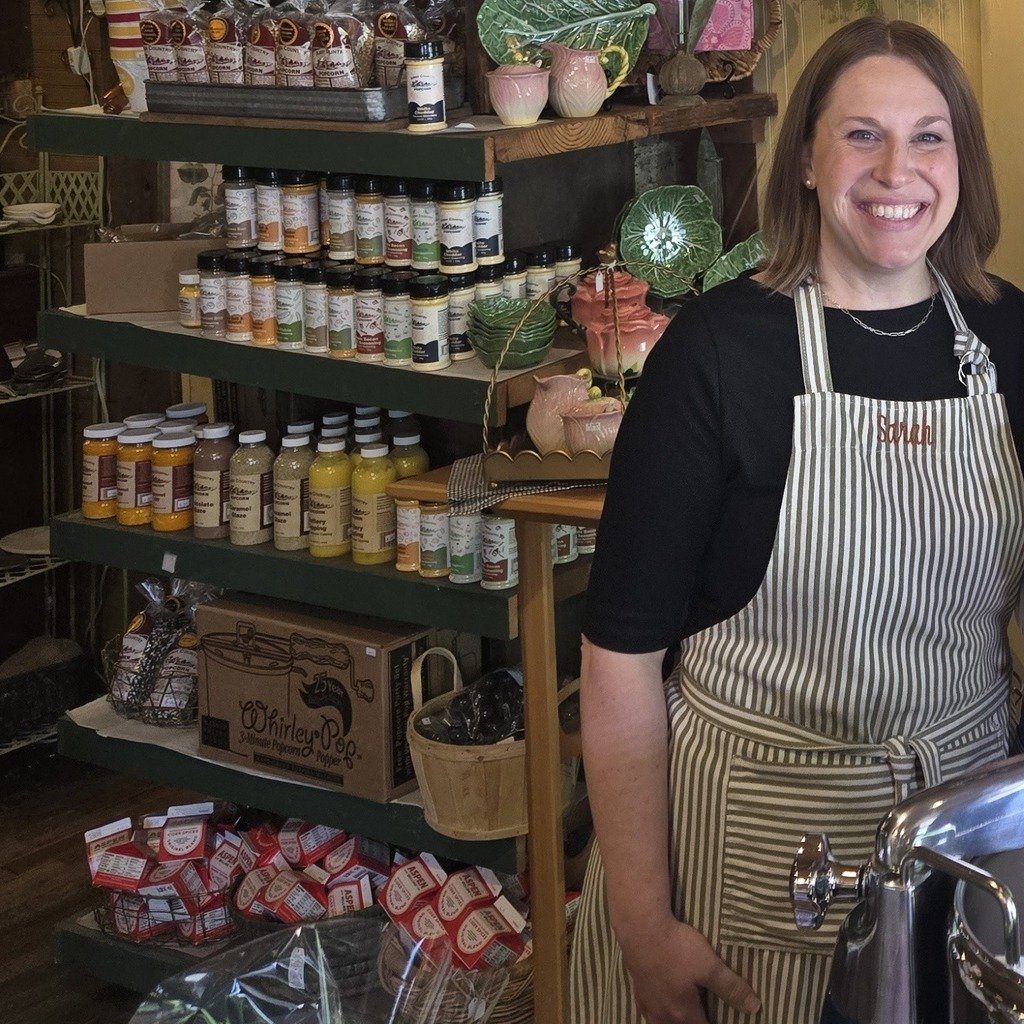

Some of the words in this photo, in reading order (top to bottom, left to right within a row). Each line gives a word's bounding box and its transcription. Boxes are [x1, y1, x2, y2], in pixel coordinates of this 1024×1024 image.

[877, 414, 934, 446] Sarah
[407, 866, 429, 889] ASPEN
[344, 889, 355, 912] ASPE
